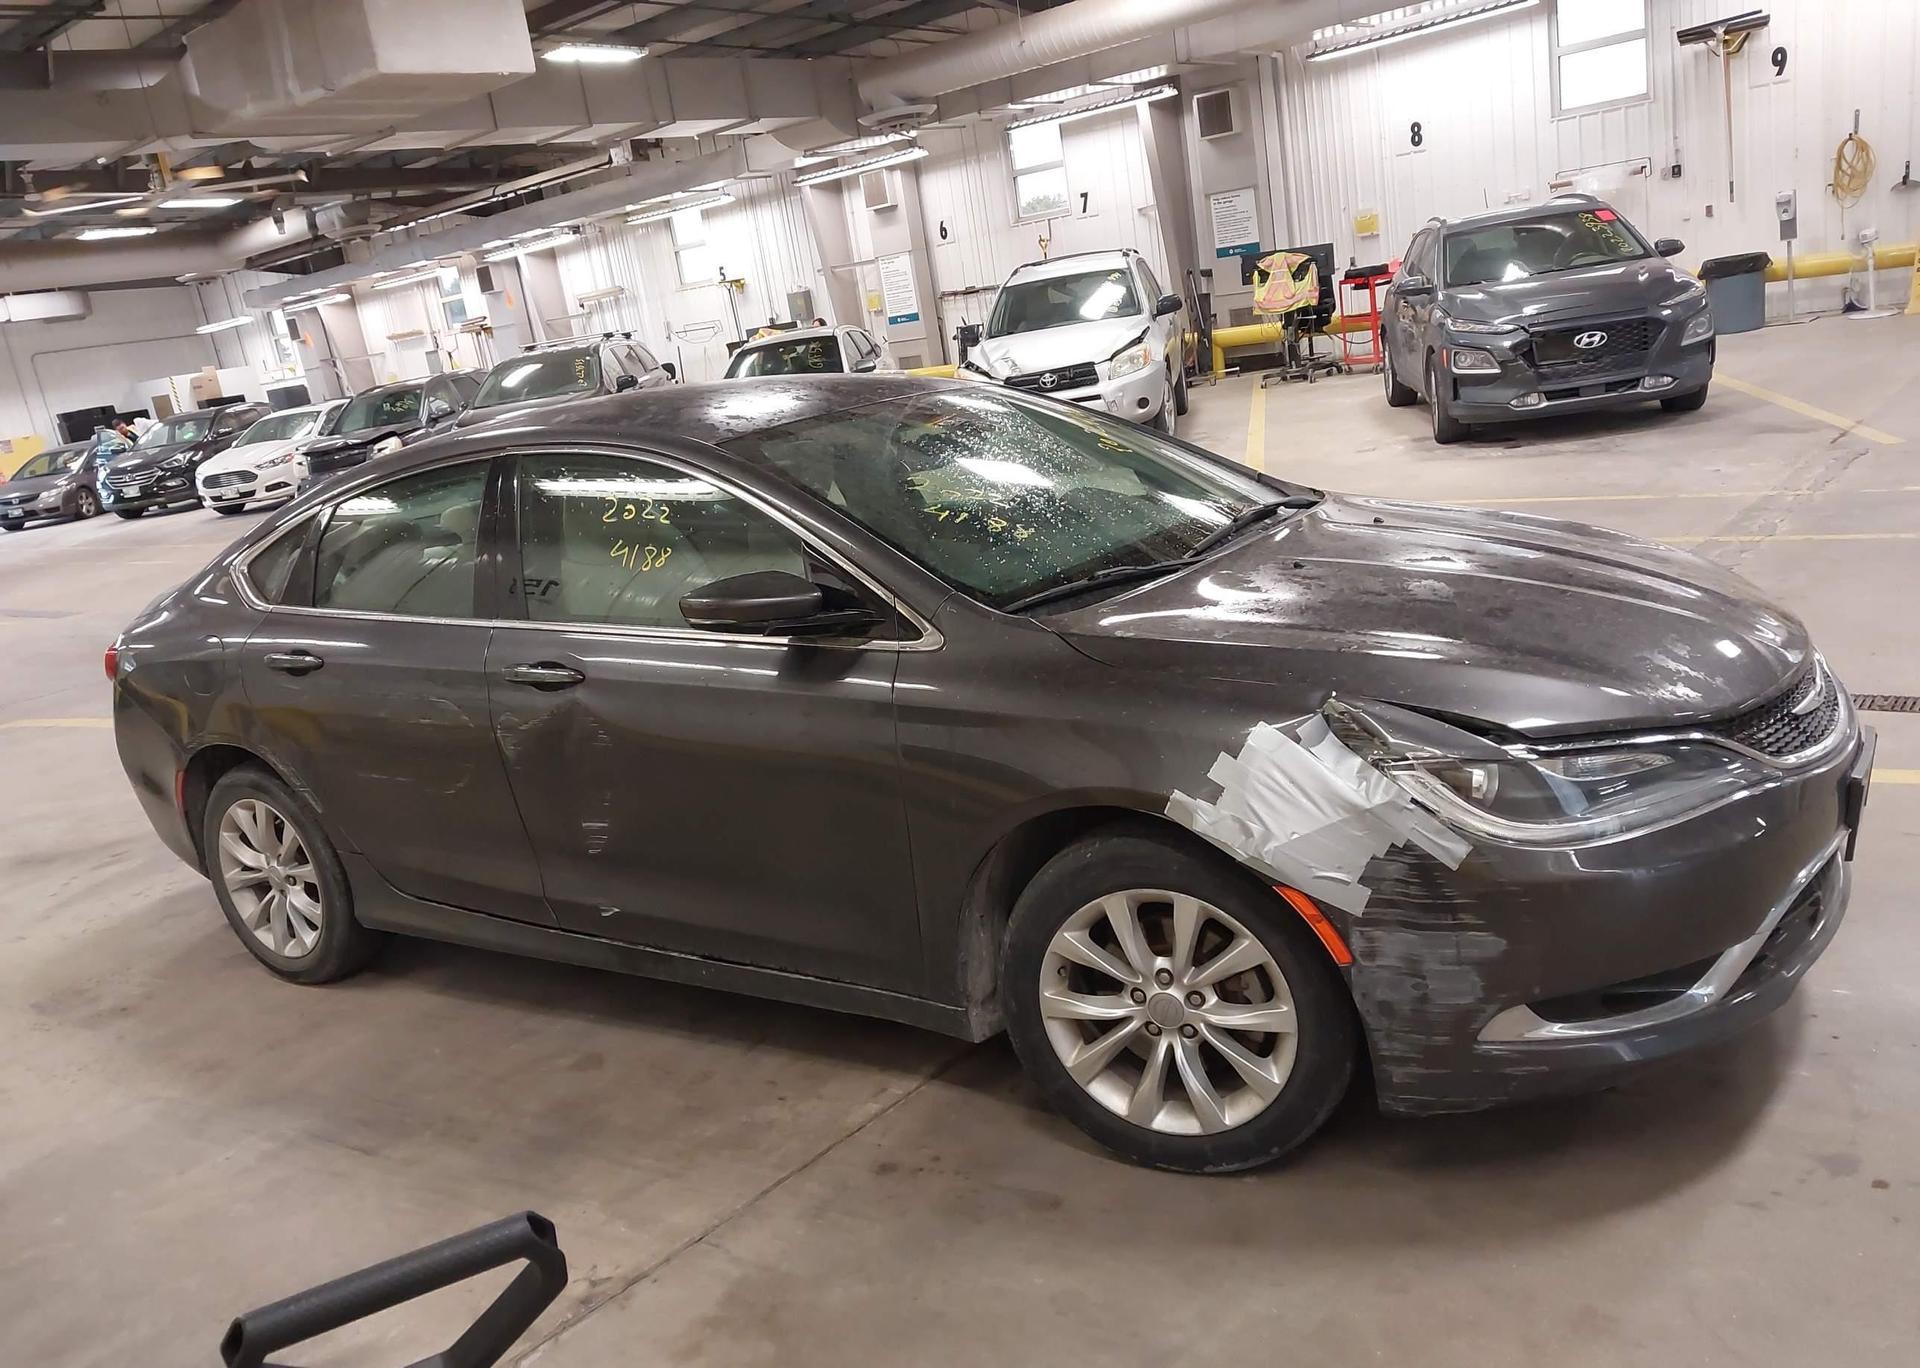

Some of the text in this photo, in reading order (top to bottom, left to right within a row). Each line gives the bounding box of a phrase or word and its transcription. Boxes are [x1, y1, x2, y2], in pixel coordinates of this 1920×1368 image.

[1771, 46, 1788, 77] 9
[1410, 121, 1423, 147] 8
[1080, 192, 1089, 214] 7
[939, 220, 948, 240] 6
[719, 266, 726, 281] 5
[602, 496, 671, 525] 2022
[610, 539, 672, 572] 4188
